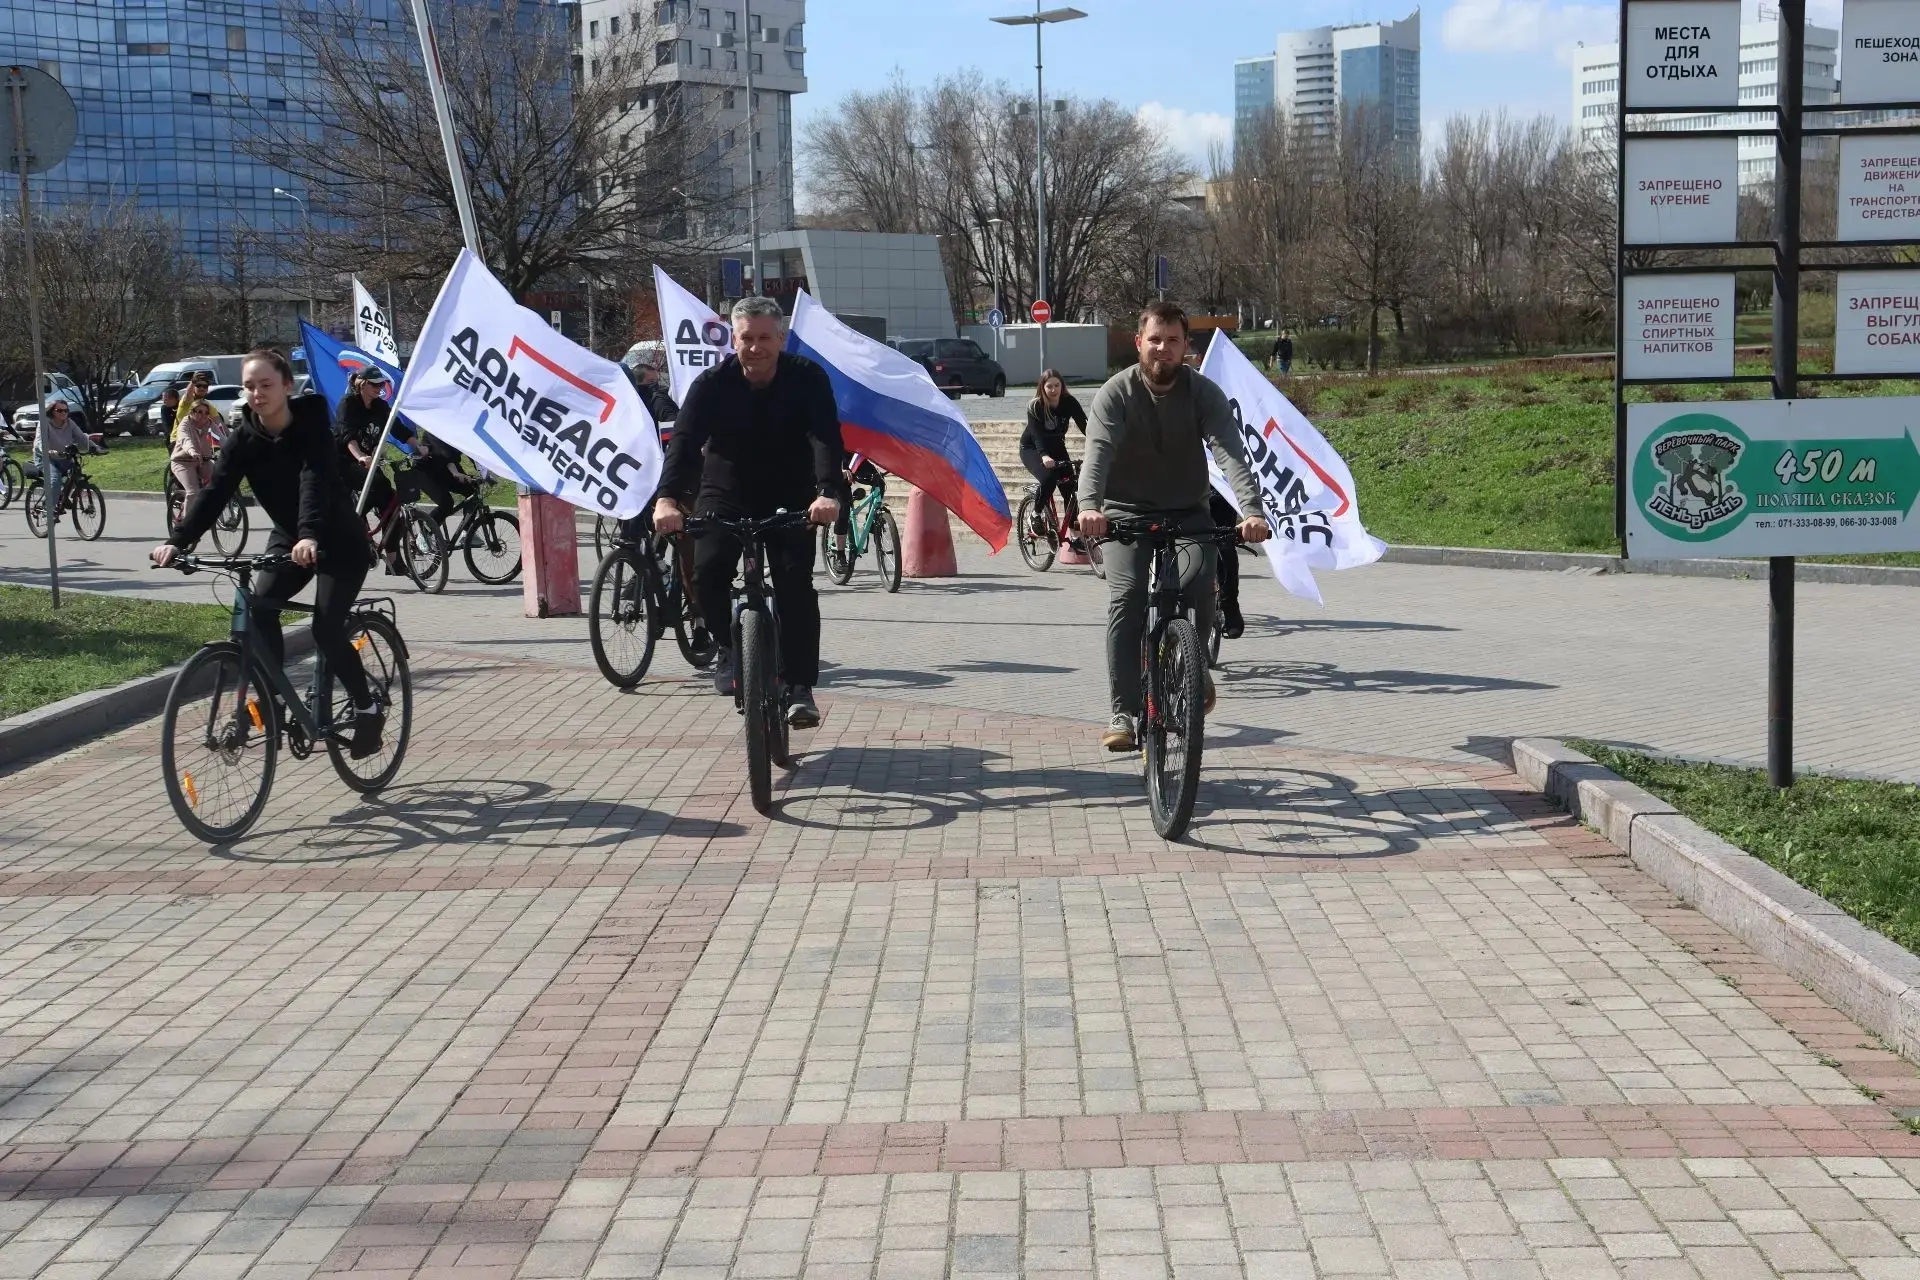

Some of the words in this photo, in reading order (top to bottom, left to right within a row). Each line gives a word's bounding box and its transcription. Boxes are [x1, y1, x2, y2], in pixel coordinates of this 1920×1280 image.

[1655, 26, 1711, 40] МЕСТА
[1855, 37, 1920, 49] ПЕШЕХОД
[1664, 46, 1699, 61] ДЛЯ
[1882, 52, 1918, 62] ЗОНА
[1646, 64, 1718, 81] ОТДЫХА
[1638, 179, 1722, 192] ЗАПРЕЩЕНО
[1888, 184, 1905, 192] НА
[1650, 194, 1711, 206] КУРЕНИЕ
[1637, 297, 1720, 310] ЗАПРЕЩЕНО
[1849, 296, 1919, 311] ЗАПРЕЩ
[1645, 312, 1713, 324] РАСПИТИЕ
[1867, 314, 1920, 327] ВЫГУЛ
[1642, 326, 1715, 339] СПИРТНЫХ
[1867, 332, 1920, 345] СОБАК
[1643, 342, 1714, 354] НАПИТКОВ
[450, 327, 642, 491] ДОНБАСС
[444, 347, 618, 511] ТЕПЛОЭНЕРГО
[1715, 437, 1740, 453] ПАРК
[1774, 449, 1844, 485] 450
[1757, 493, 1827, 508] ПОЛЯНА
[1830, 491, 1897, 506] СКАЗОК
[1650, 497, 1692, 522] ЛЕНЬ
[1700, 497, 1742, 521] ПЕНЬ
